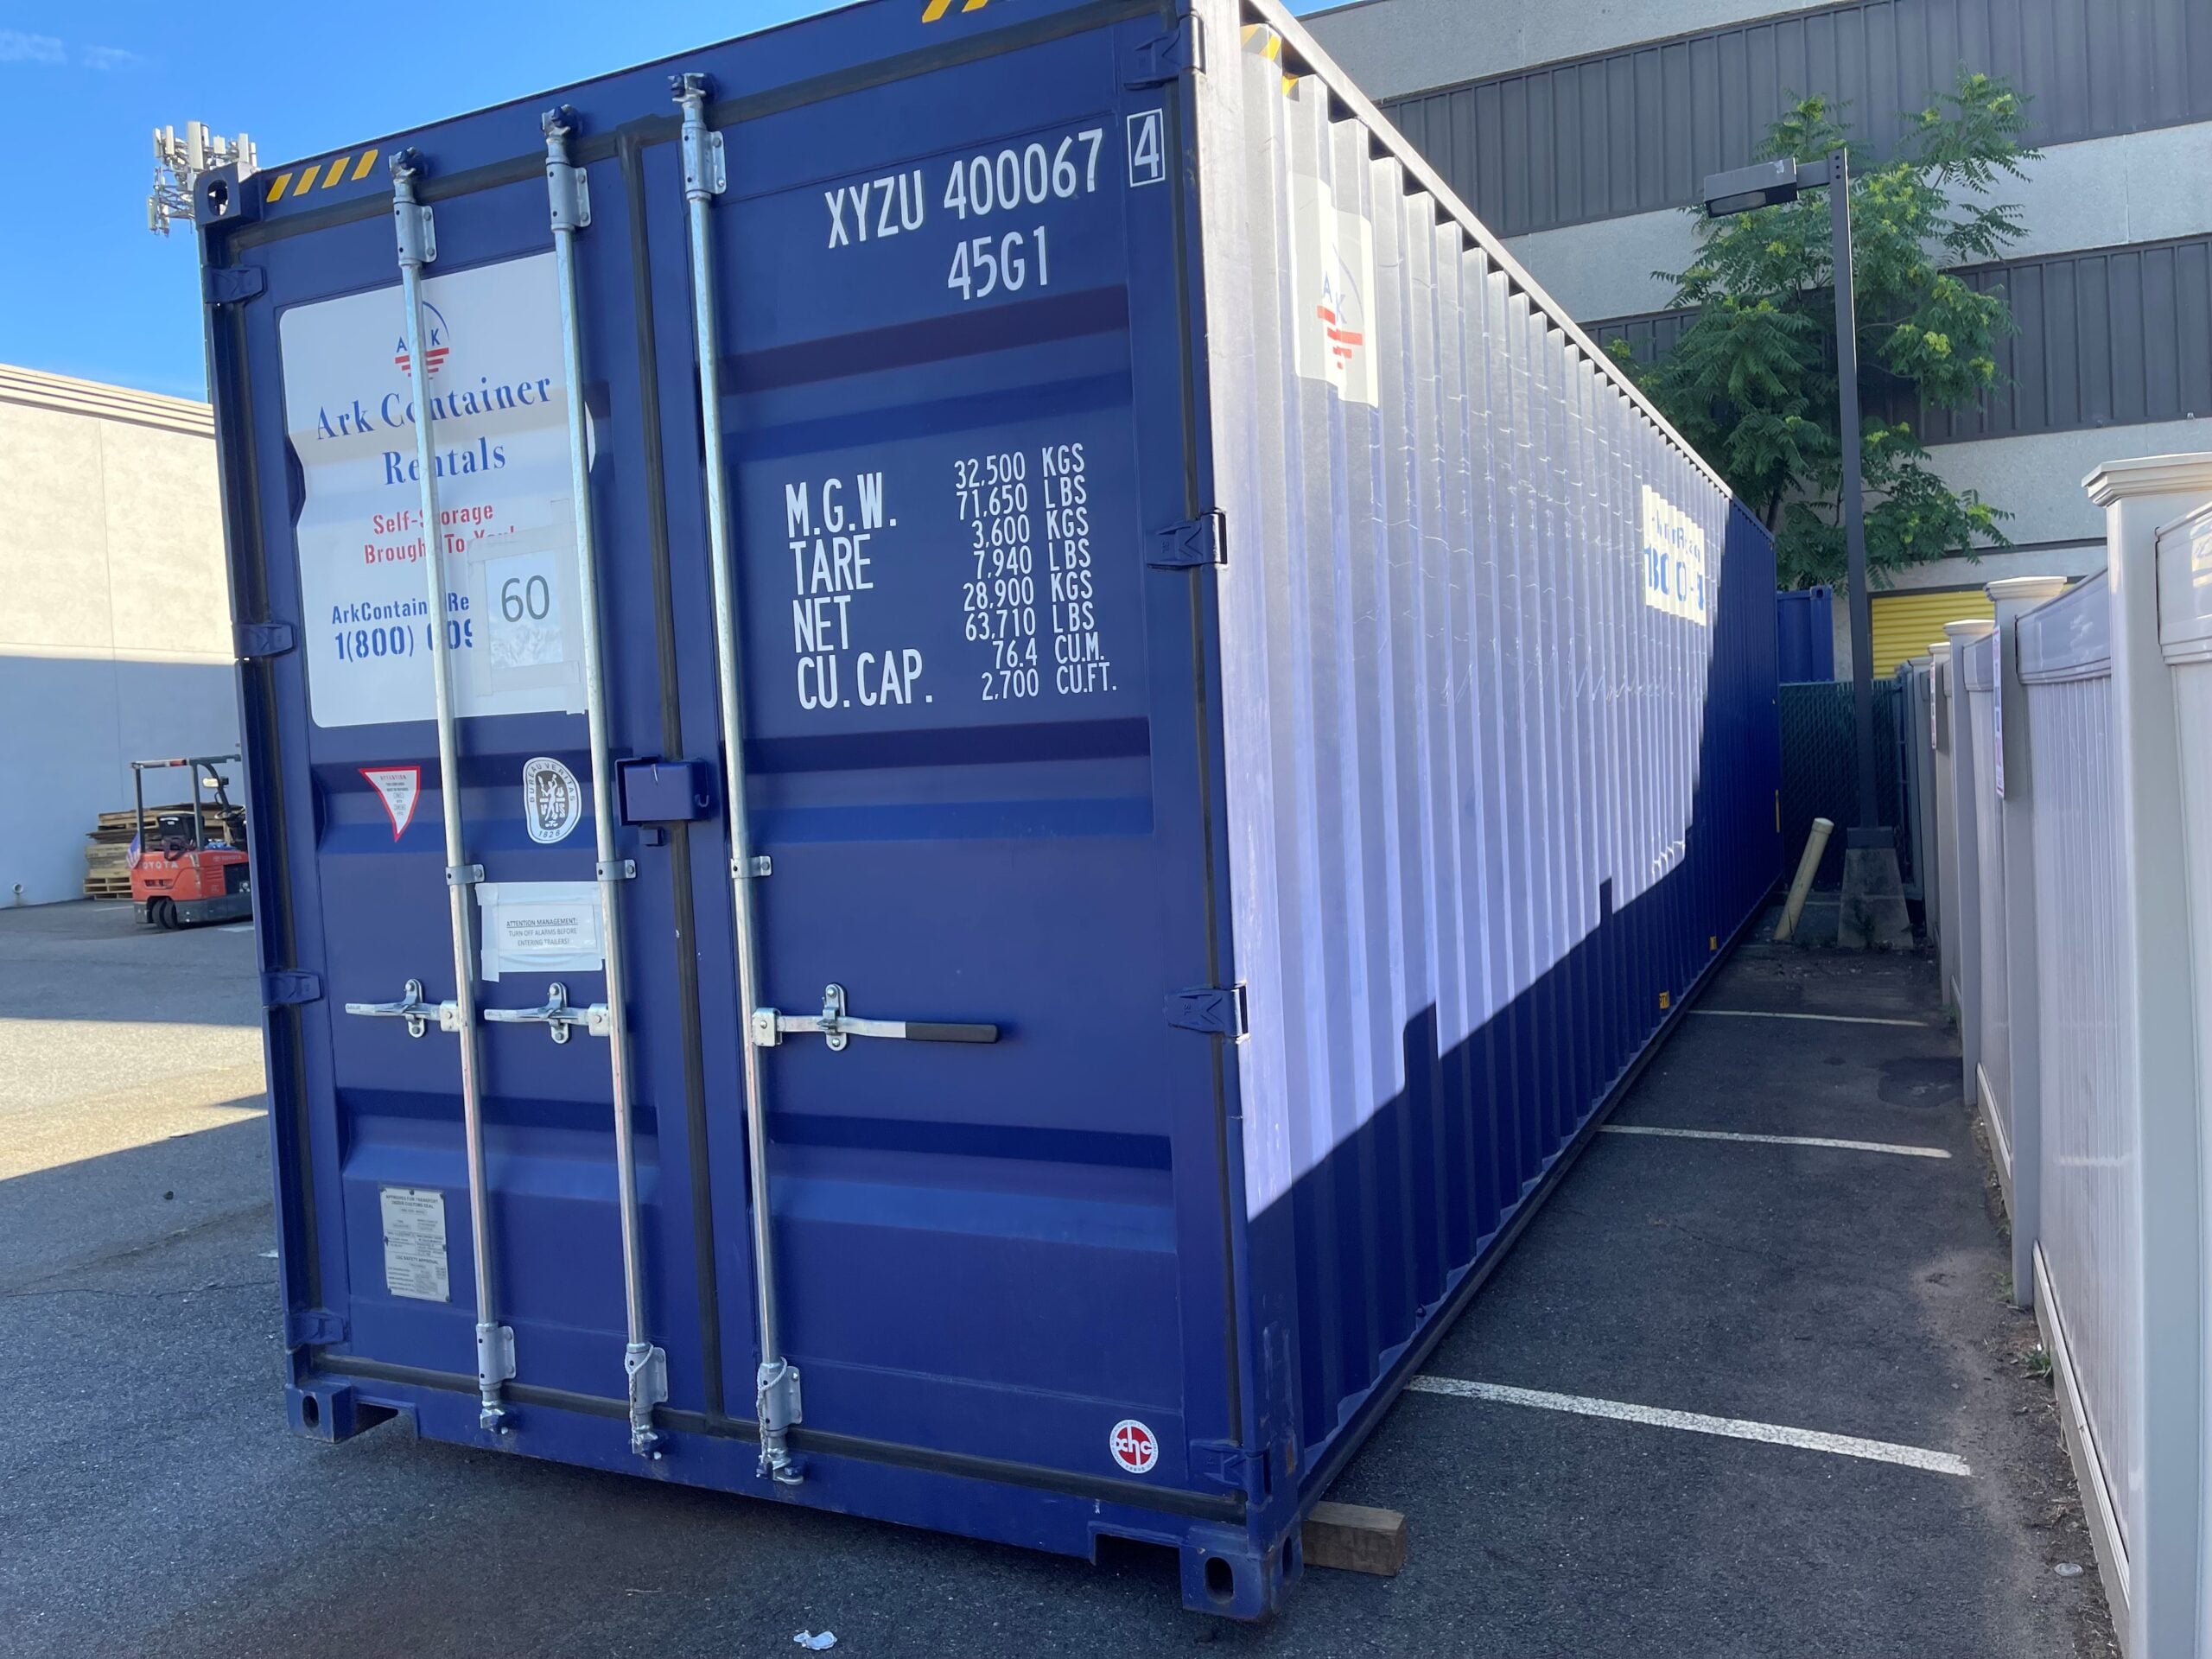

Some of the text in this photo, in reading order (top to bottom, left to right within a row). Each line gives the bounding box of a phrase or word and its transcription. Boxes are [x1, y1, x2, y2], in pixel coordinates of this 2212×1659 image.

[824, 115, 1161, 249] XYZU 400067 4
[948, 226, 1048, 301] 45G1
[317, 399, 376, 440] Ark
[954, 442, 1085, 490] 32,500 KGS
[785, 471, 897, 538] M.G.W.
[956, 475, 1087, 520] 71,650 LBS
[373, 505, 493, 535] Self-orage
[971, 506, 1090, 549] 3,600 KGS
[364, 533, 465, 564] Brough To
[789, 534, 874, 595] TARE
[973, 538, 1091, 580] 7,940 LBS
[501, 575, 550, 623] 60
[963, 570, 1093, 612] 28,900 KGS
[792, 594, 851, 653] NET
[965, 601, 1095, 640] 63,710 LBS
[335, 624, 414, 663] 1(800)
[993, 638, 1038, 669] 76.4
[982, 668, 1039, 701] 2,700
[544, 763, 576, 802] VERITAS
